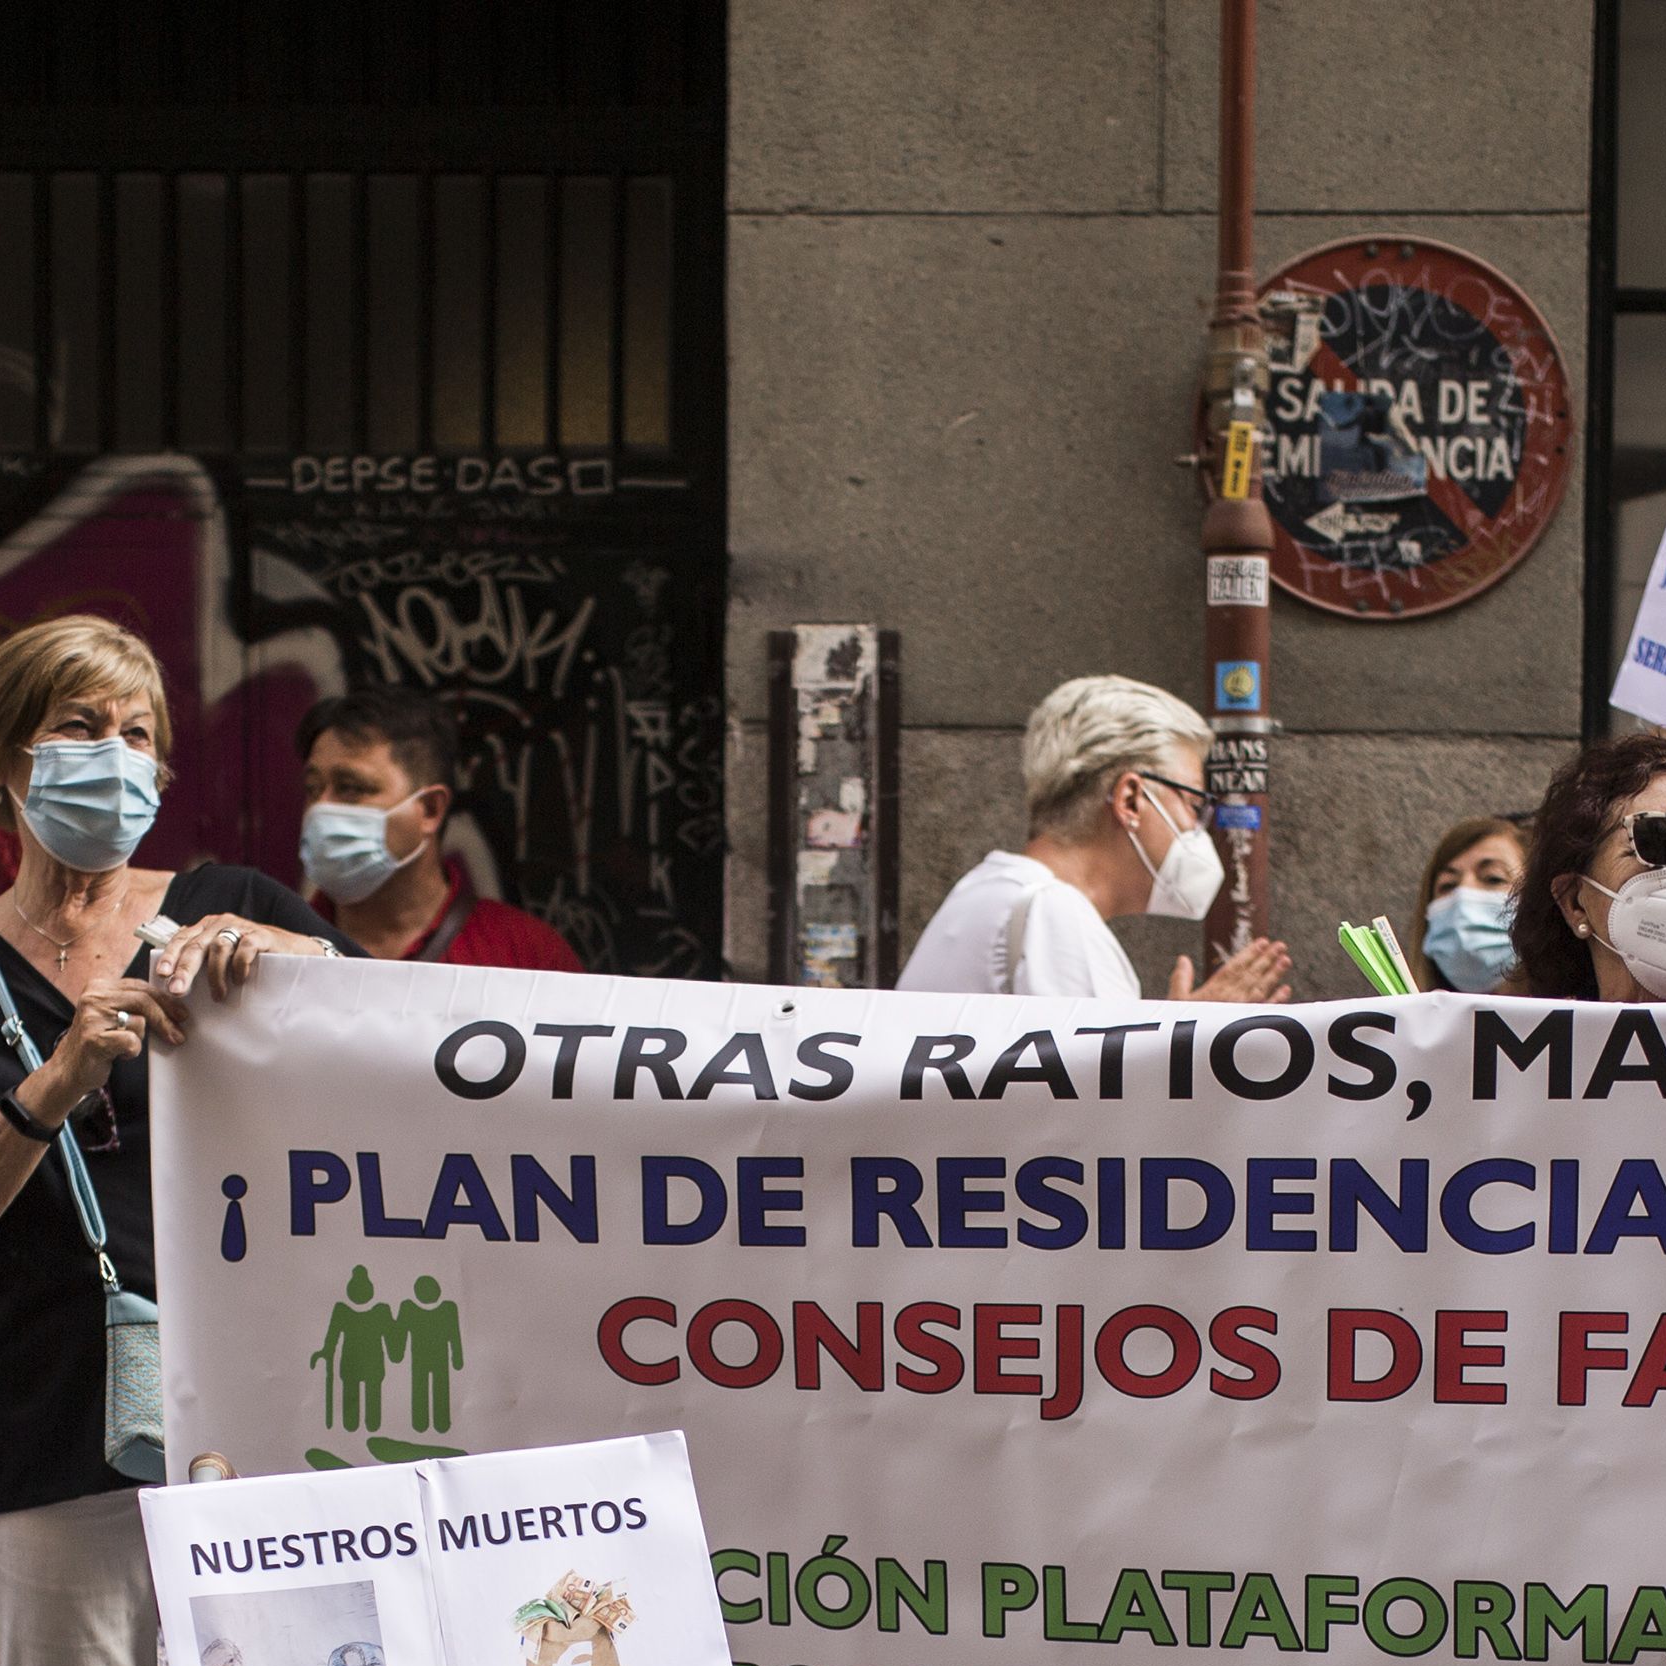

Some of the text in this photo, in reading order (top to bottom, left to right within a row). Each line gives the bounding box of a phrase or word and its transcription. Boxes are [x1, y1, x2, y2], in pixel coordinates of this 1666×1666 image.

[1275, 378, 1491, 423] SAA DE
[1261, 434, 1514, 481] EMNCIA
[434, 1019, 861, 1101] OTRAS
[899, 1010, 1432, 1122] RATIOS,
[288, 1149, 599, 1244] PLAN
[641, 1155, 807, 1247] DE
[597, 1295, 1282, 1420] CONSEJOS
[1327, 1307, 1509, 1405] DE
[189, 1498, 649, 1577] NUESTROS MUERTOS
[708, 1535, 948, 1635] CIÓN
